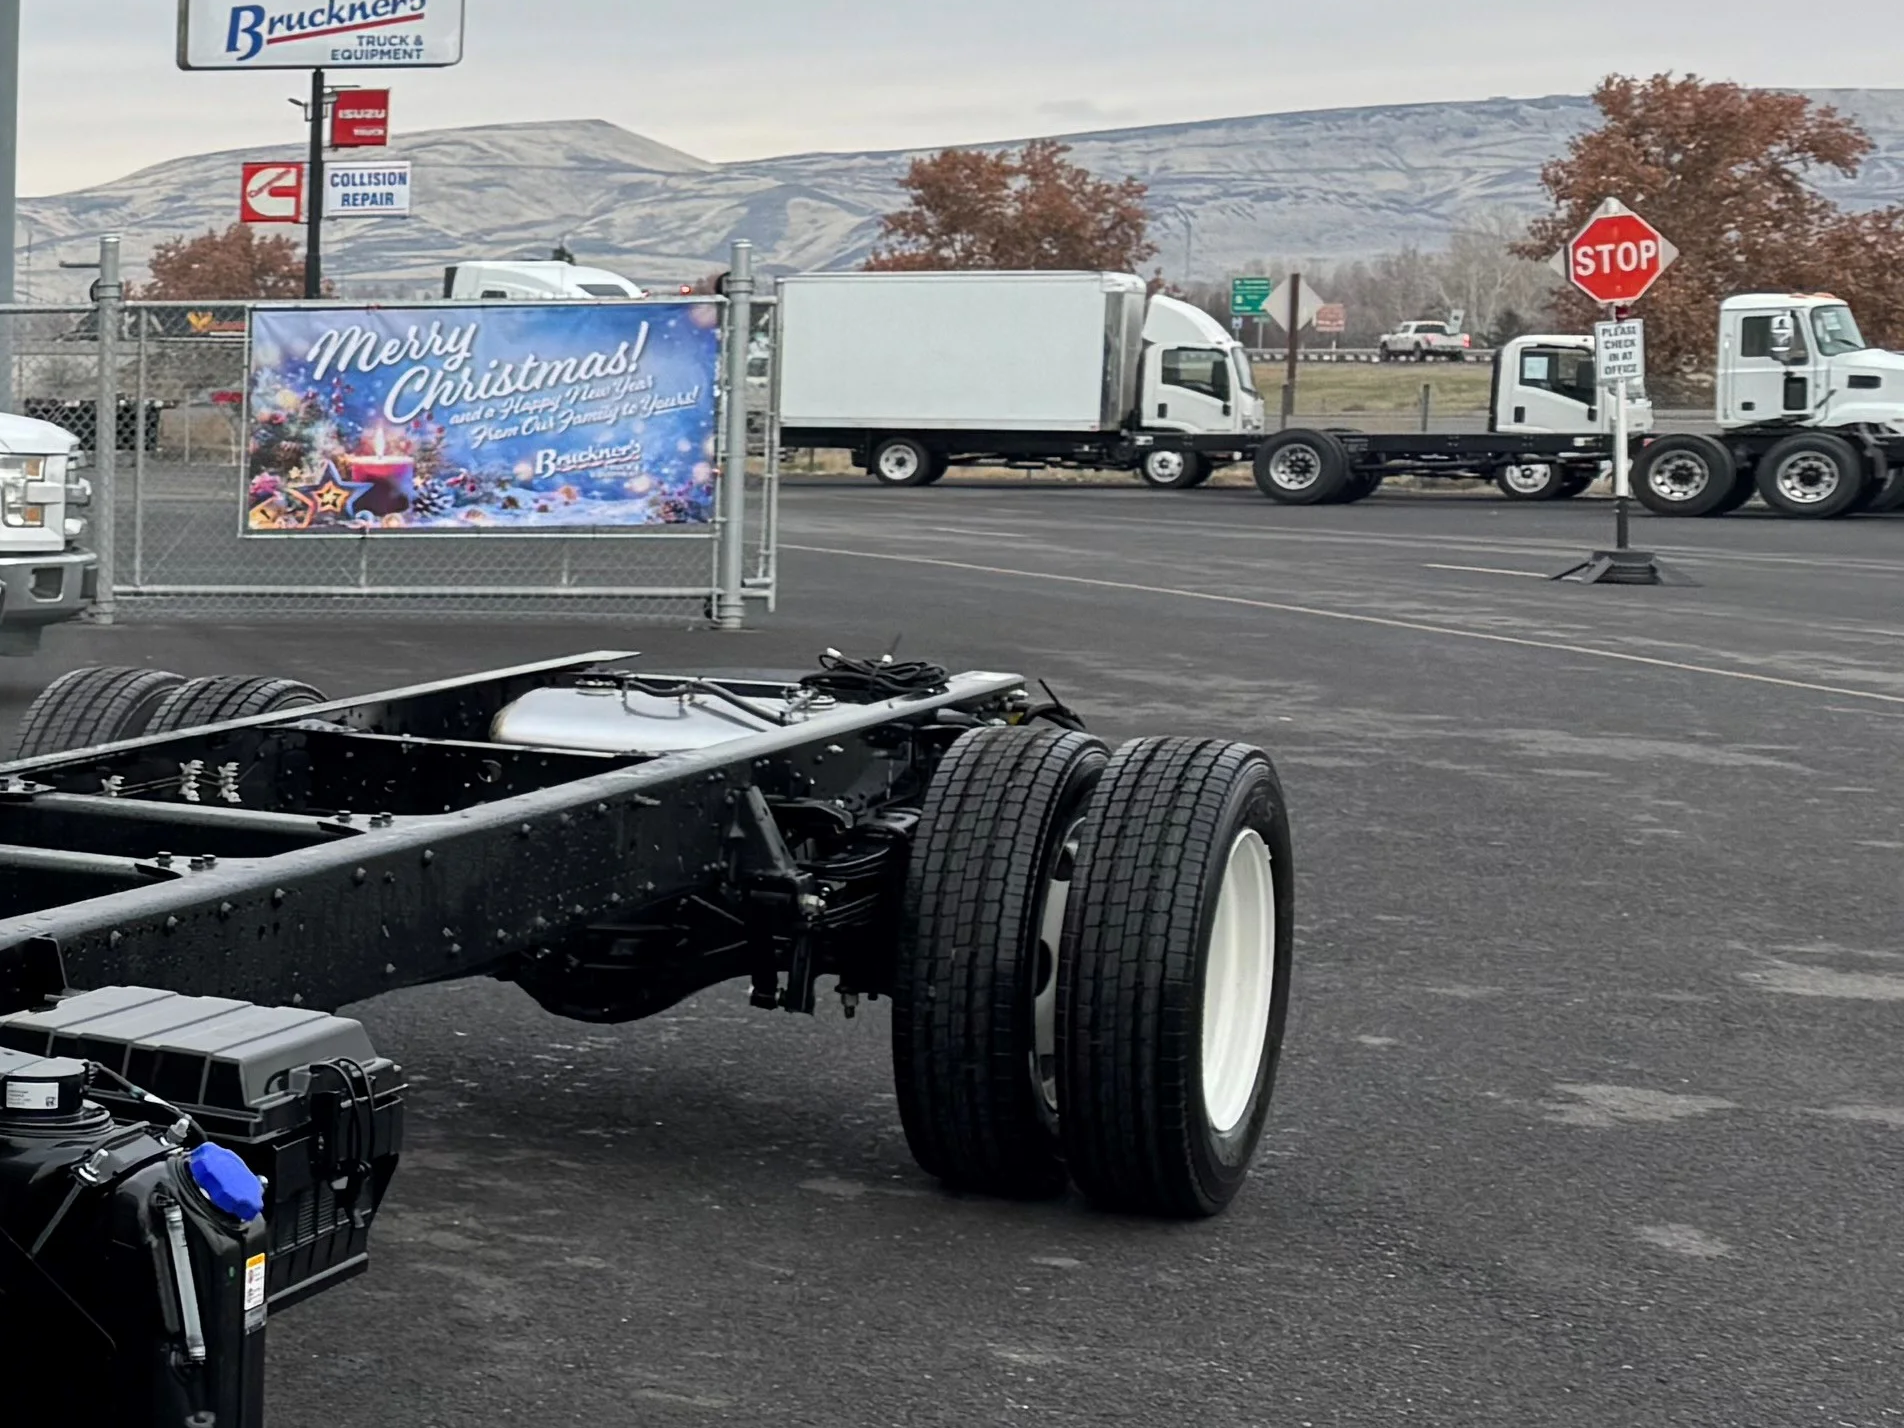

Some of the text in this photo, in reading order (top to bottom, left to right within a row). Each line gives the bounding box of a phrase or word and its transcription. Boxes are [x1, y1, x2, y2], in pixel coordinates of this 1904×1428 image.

[356, 34, 423, 47] TRUCK &
[330, 48, 424, 61] EQUIPMENT
[338, 108, 385, 120] ISUZU
[330, 172, 408, 188] COLLISION
[341, 192, 394, 208] REPAIR
[1575, 239, 1657, 277] STOP
[1602, 325, 1637, 337] PLEASE
[307, 320, 478, 381] Merry
[1604, 339, 1636, 350] CHECK
[1609, 351, 1632, 362] IN AT
[383, 320, 649, 424] Christmas!
[1604, 363, 1637, 376] OFFICE
[449, 376, 653, 425] and a Happy New Year
[470, 385, 700, 449] From Our Family to Yours!
[535, 438, 641, 478] Bruckner's
